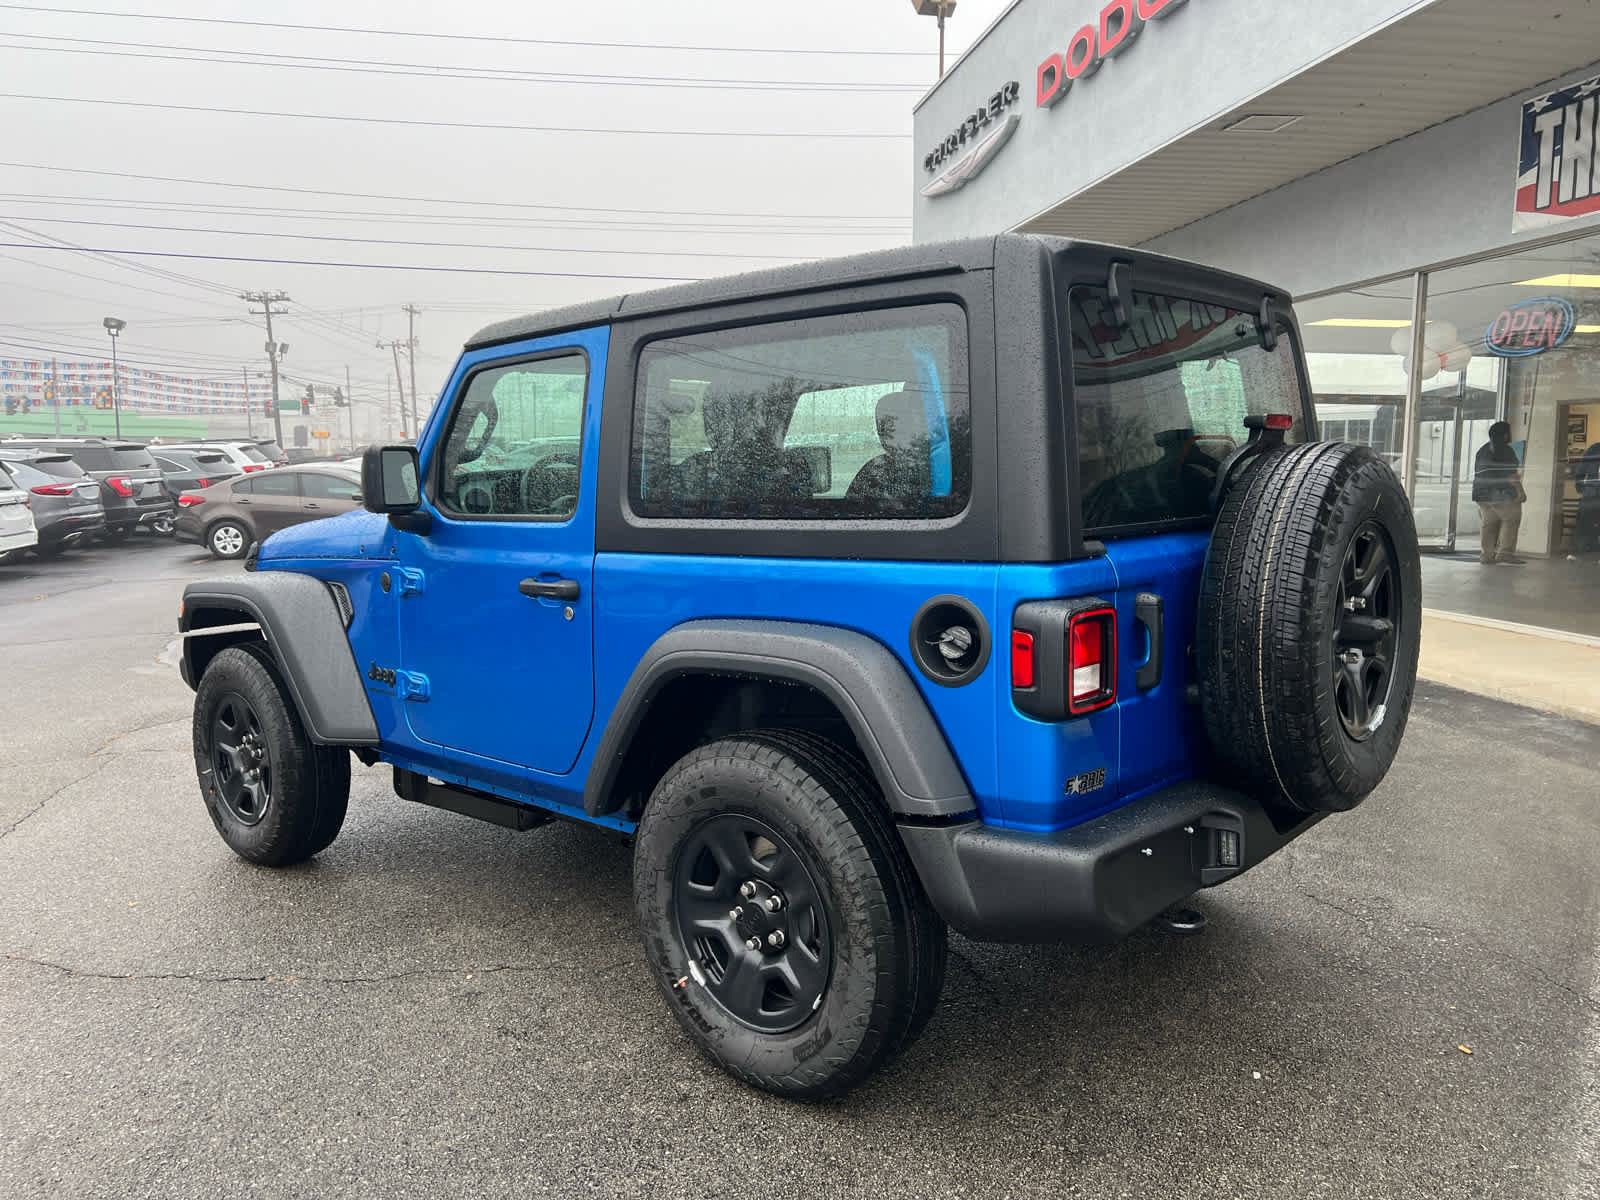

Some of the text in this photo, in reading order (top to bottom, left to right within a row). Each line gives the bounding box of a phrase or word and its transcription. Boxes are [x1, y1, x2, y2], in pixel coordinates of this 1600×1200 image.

[1534, 93, 1600, 211] TH
[1491, 310, 1564, 347] OPEN
[367, 660, 397, 689] Jeep
